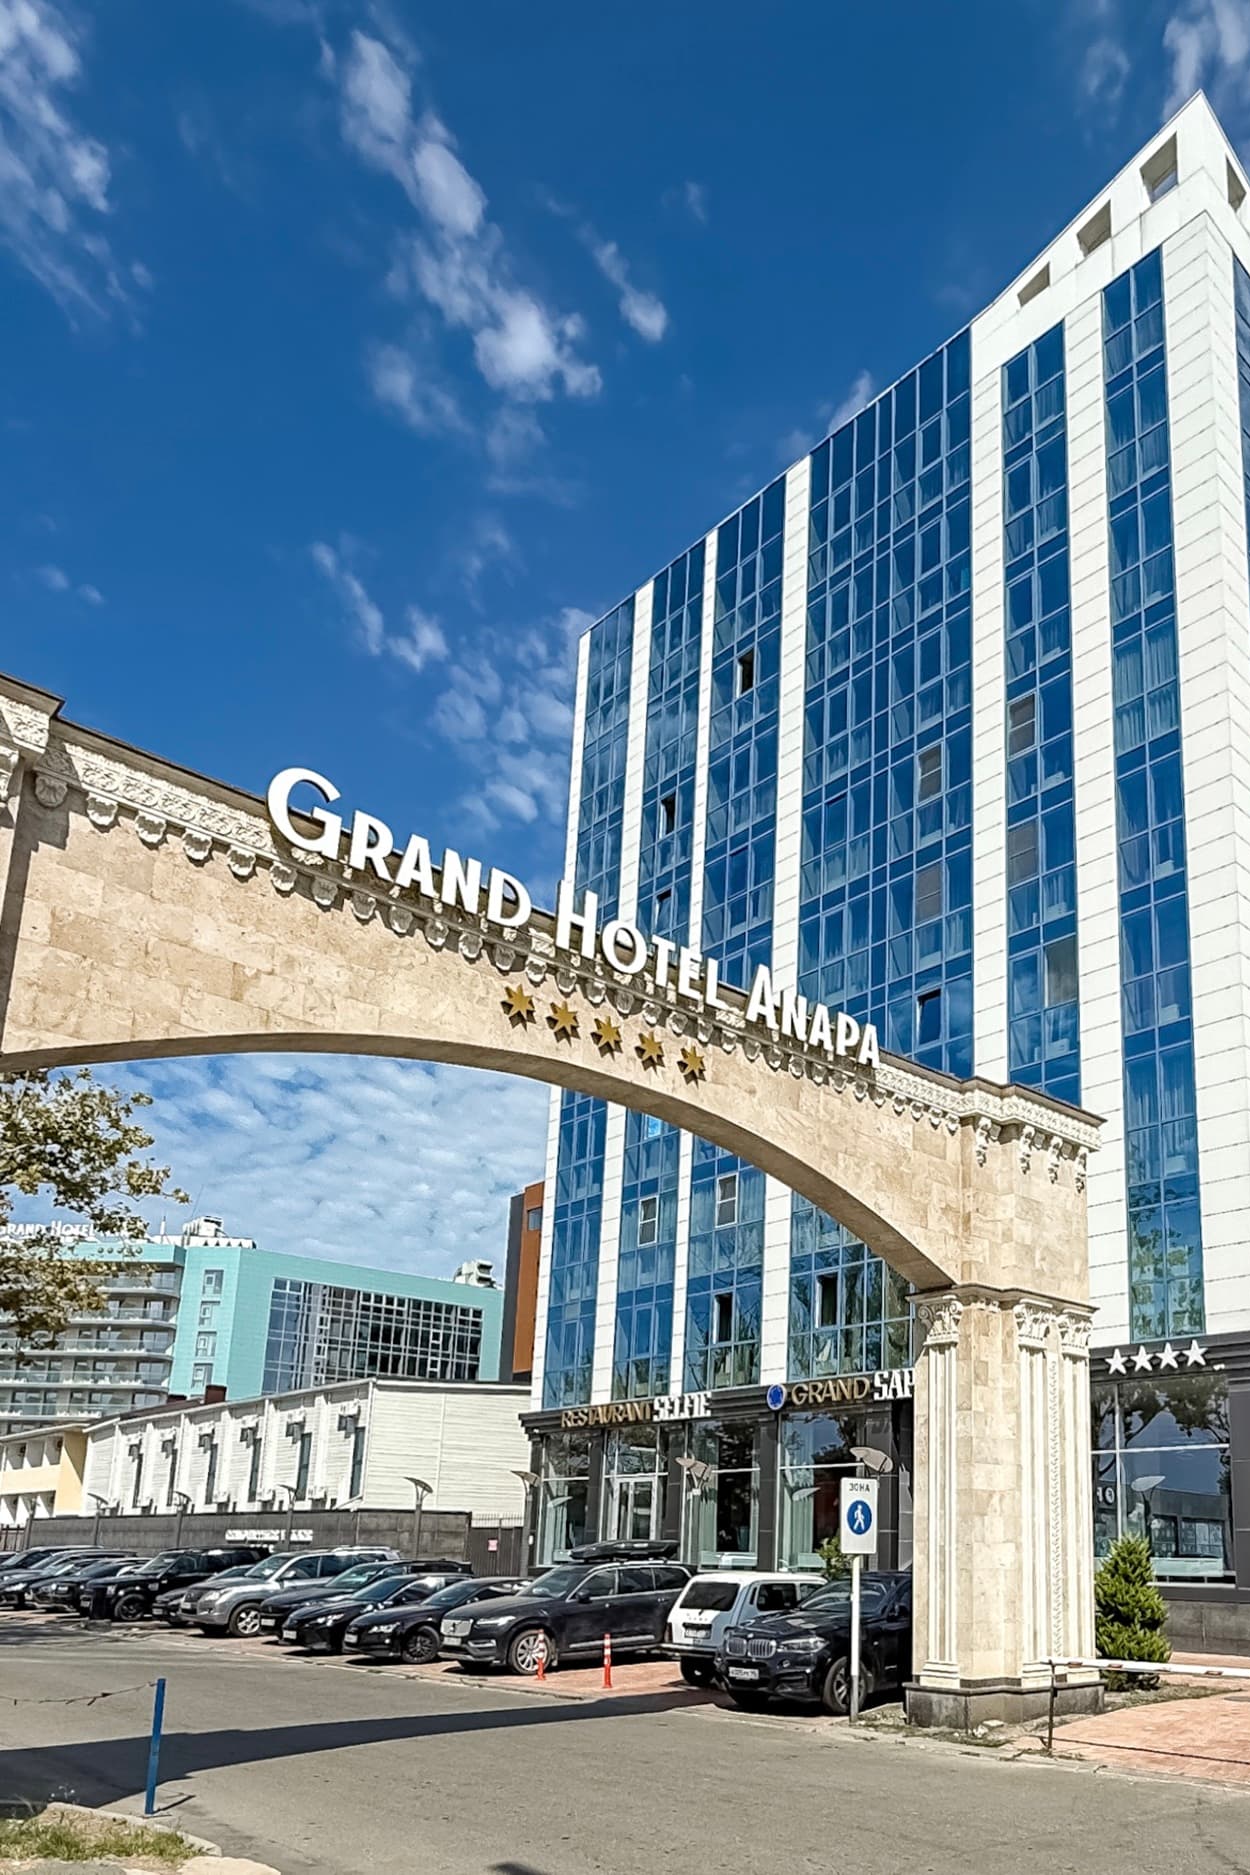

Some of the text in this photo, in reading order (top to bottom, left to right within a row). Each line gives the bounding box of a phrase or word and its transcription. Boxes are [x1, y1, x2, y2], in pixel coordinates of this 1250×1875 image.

[268, 767, 881, 1069] GRAND HOTEL ANAPA
[51, 1220, 95, 1237] HOTEL
[791, 1377, 870, 1405] GRAND
[561, 1391, 712, 1428] RESTAURANT SELFIE
[849, 1482, 871, 1492] ЗОНА
